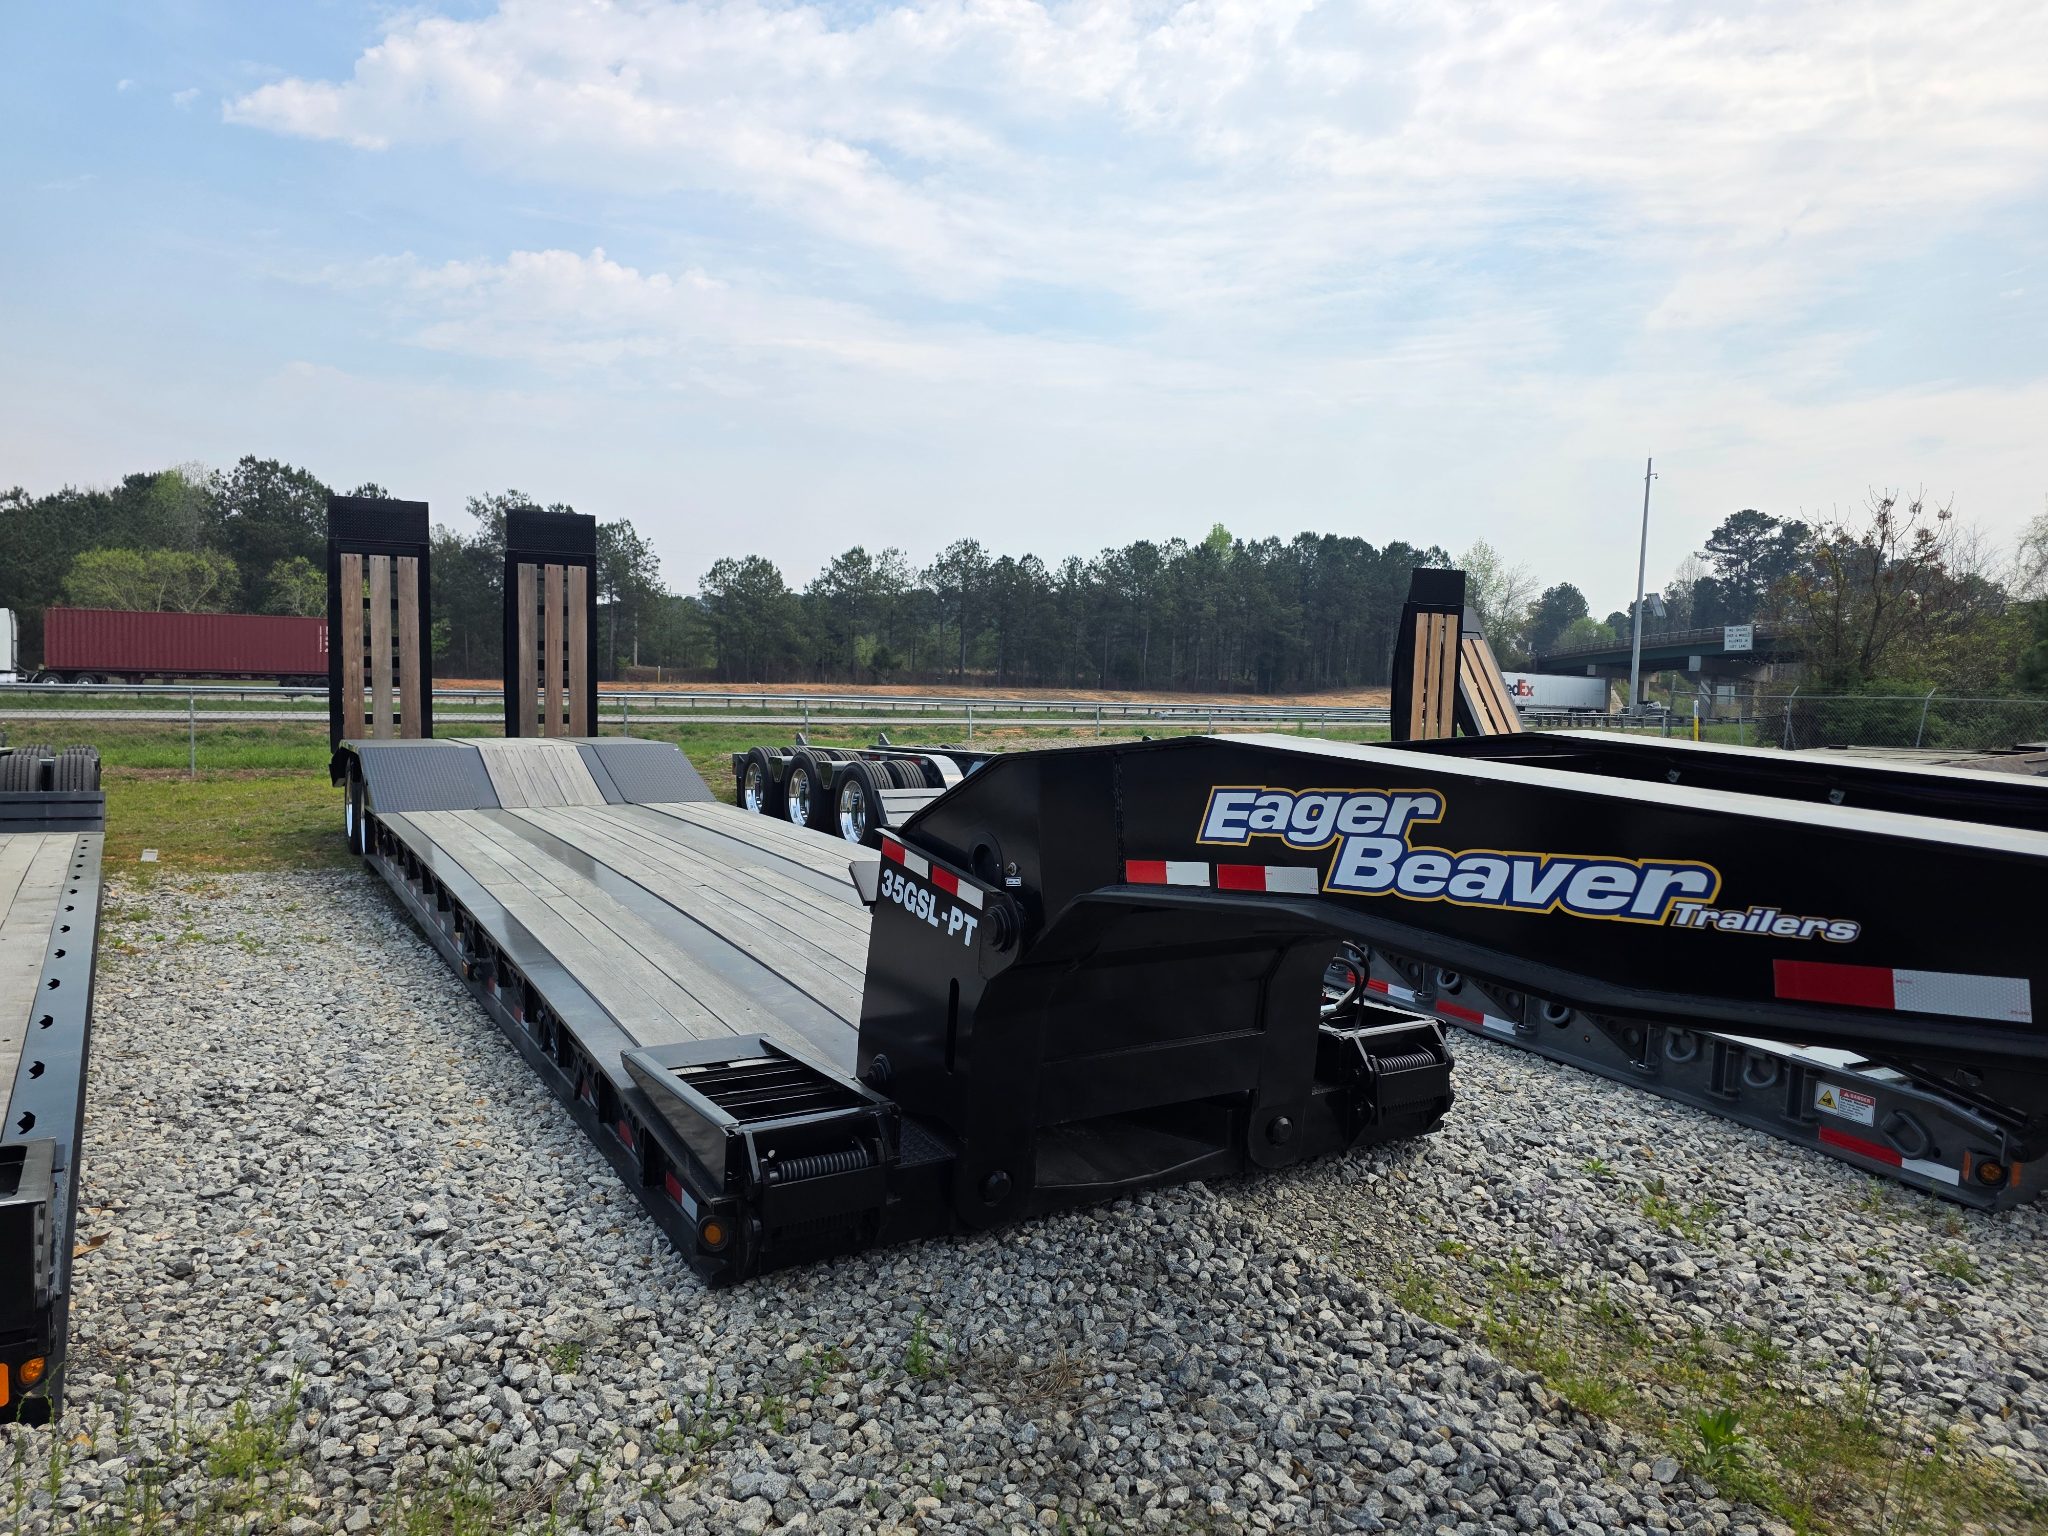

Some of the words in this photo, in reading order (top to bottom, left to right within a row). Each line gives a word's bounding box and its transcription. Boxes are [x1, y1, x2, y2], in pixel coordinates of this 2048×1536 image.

[1506, 679, 1535, 697] edEx
[1200, 789, 1441, 846] Eager
[1328, 834, 1714, 920] Beaver
[881, 868, 979, 947] 35GSL-PT
[1673, 902, 1859, 941] Trailers
